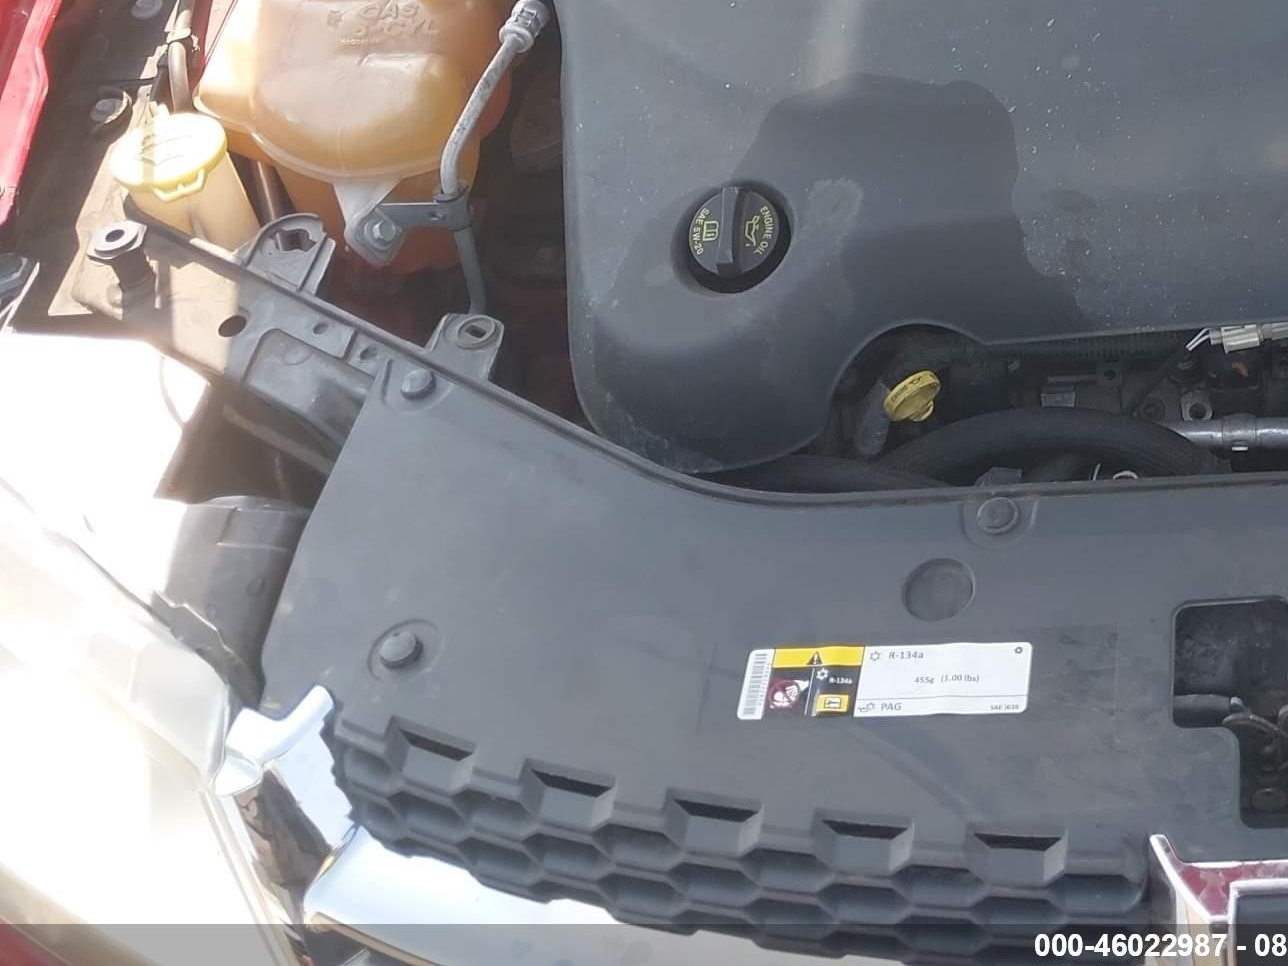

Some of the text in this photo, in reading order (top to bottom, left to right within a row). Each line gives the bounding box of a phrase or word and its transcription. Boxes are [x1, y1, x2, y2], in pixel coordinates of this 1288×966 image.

[691, 208, 710, 255] SAE 5W-20
[753, 206, 774, 255] ENGINE OIL
[888, 651, 924, 660] R-134a
[914, 674, 980, 685] 455g (1.00 lbs)
[880, 702, 902, 711] PAG
